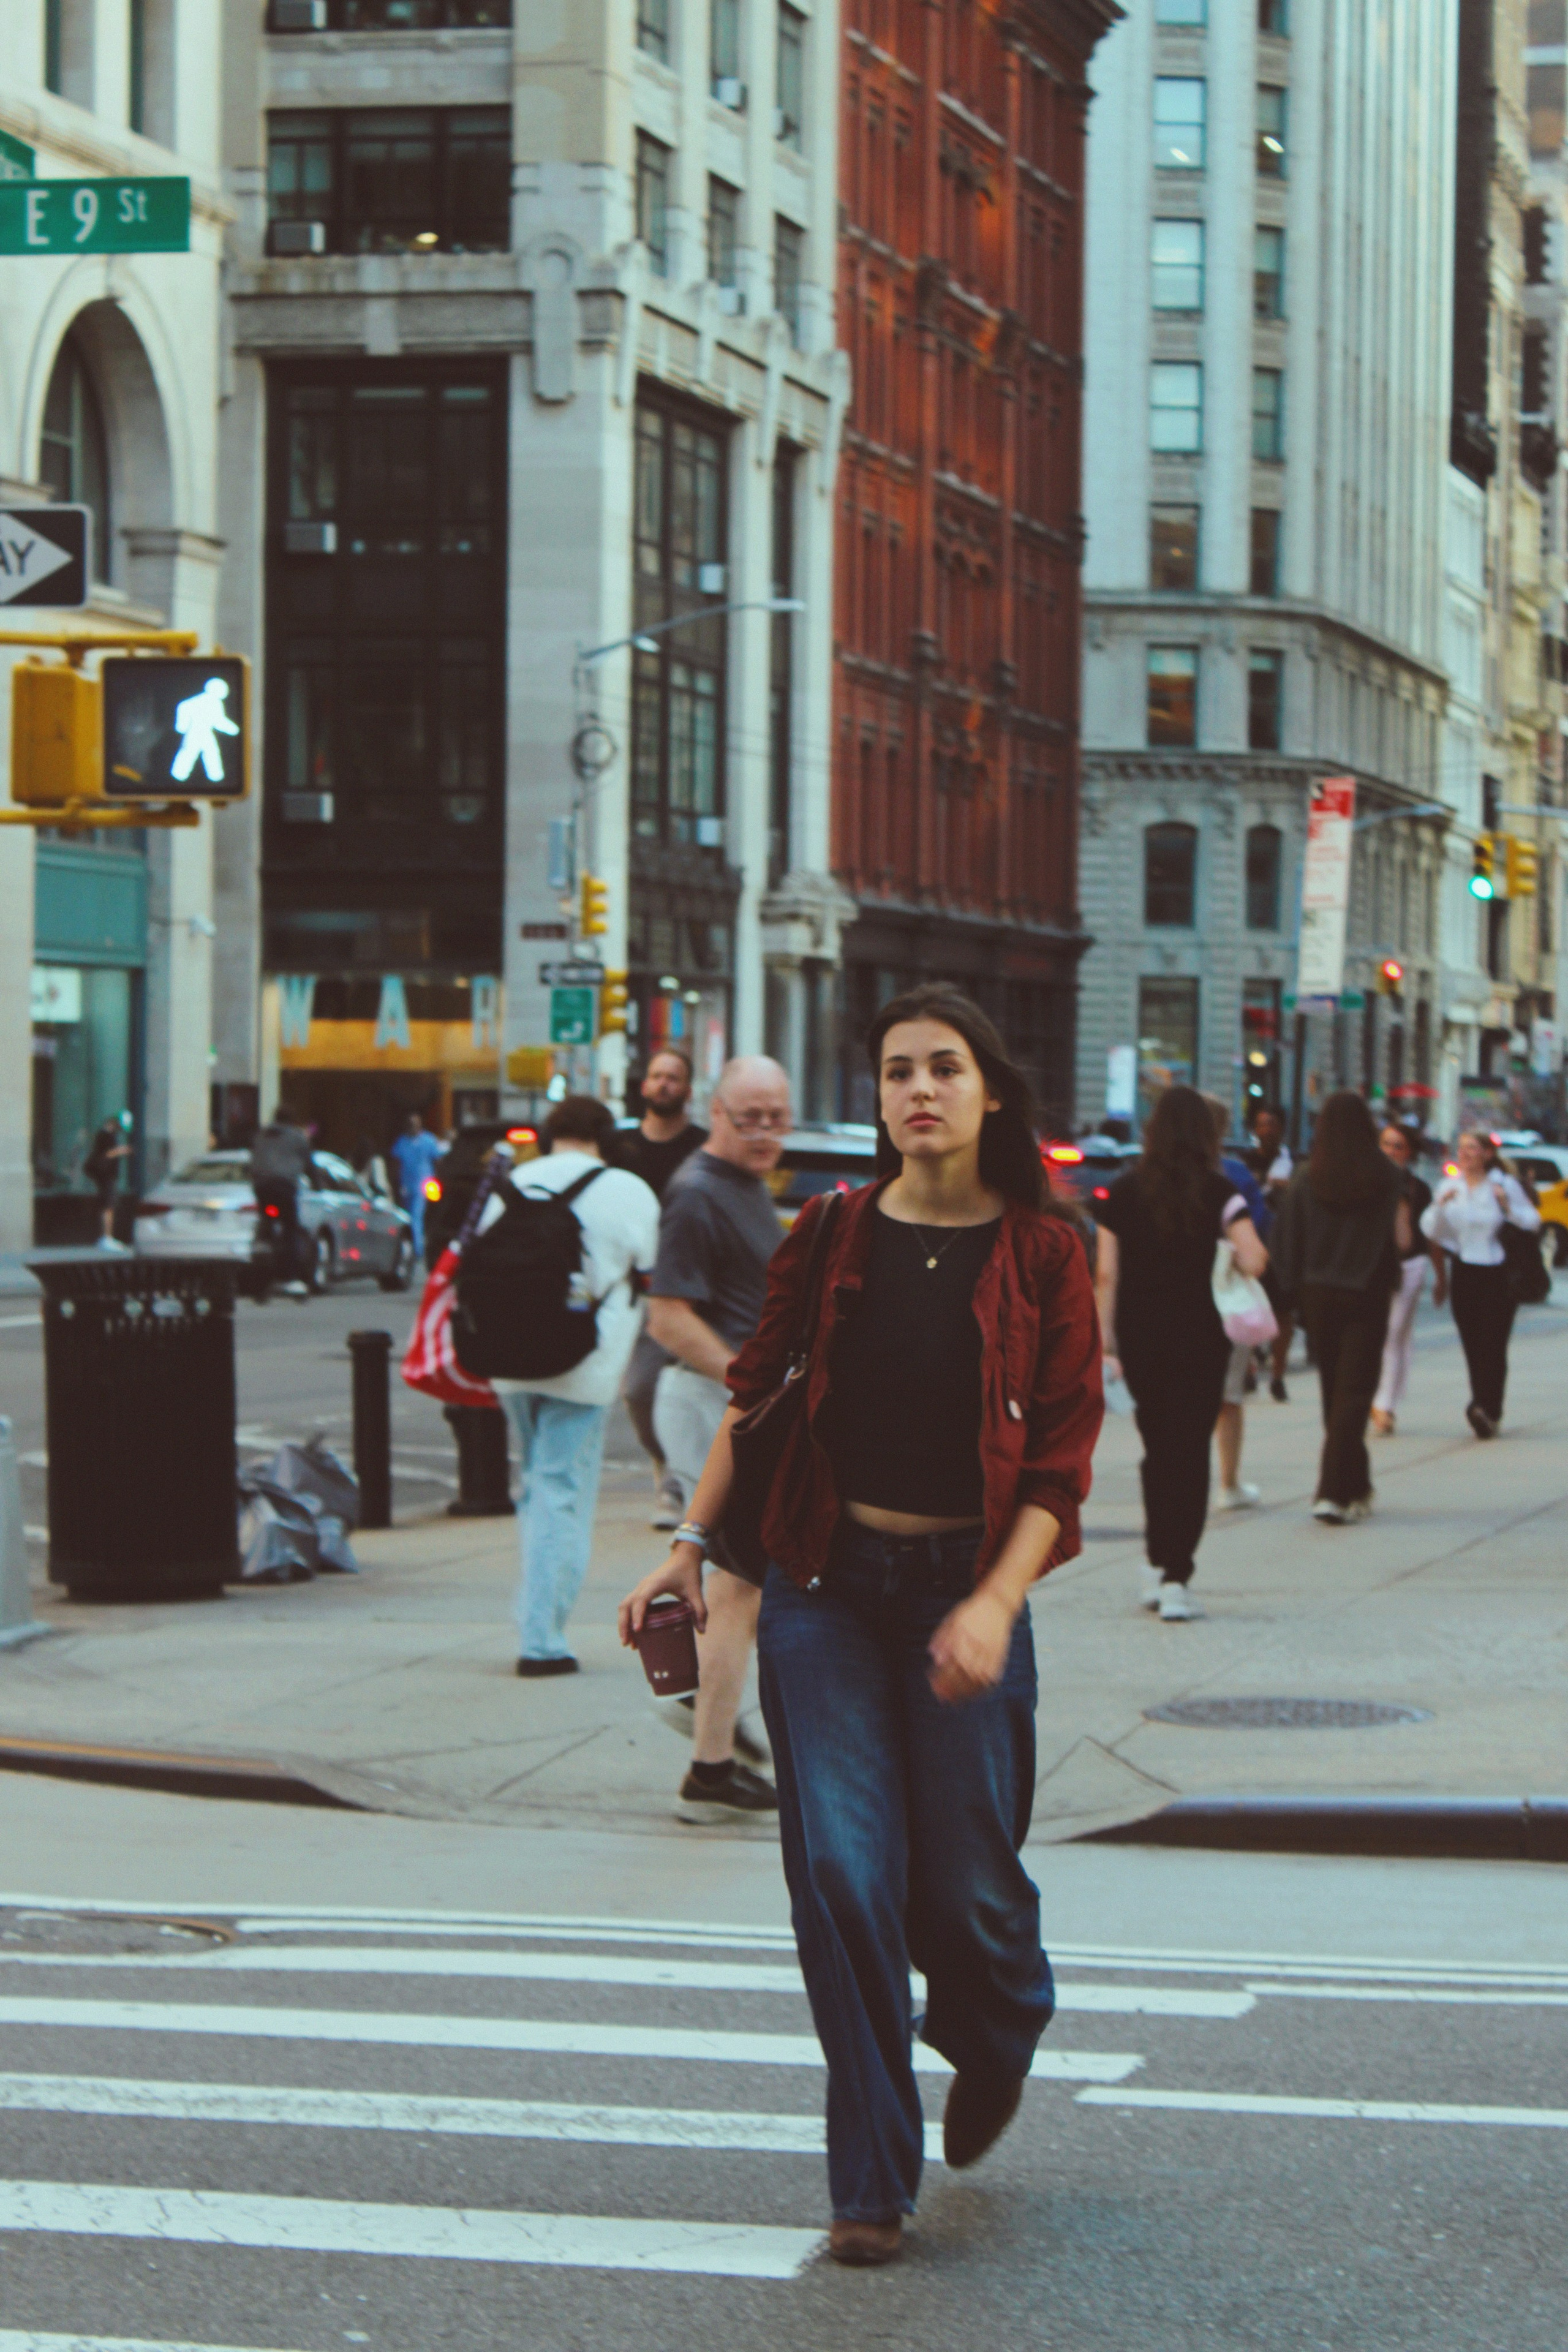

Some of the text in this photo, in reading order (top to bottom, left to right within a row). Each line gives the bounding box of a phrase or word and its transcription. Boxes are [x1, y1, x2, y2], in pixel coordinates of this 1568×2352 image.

[26, 187, 148, 245] E 9 St
